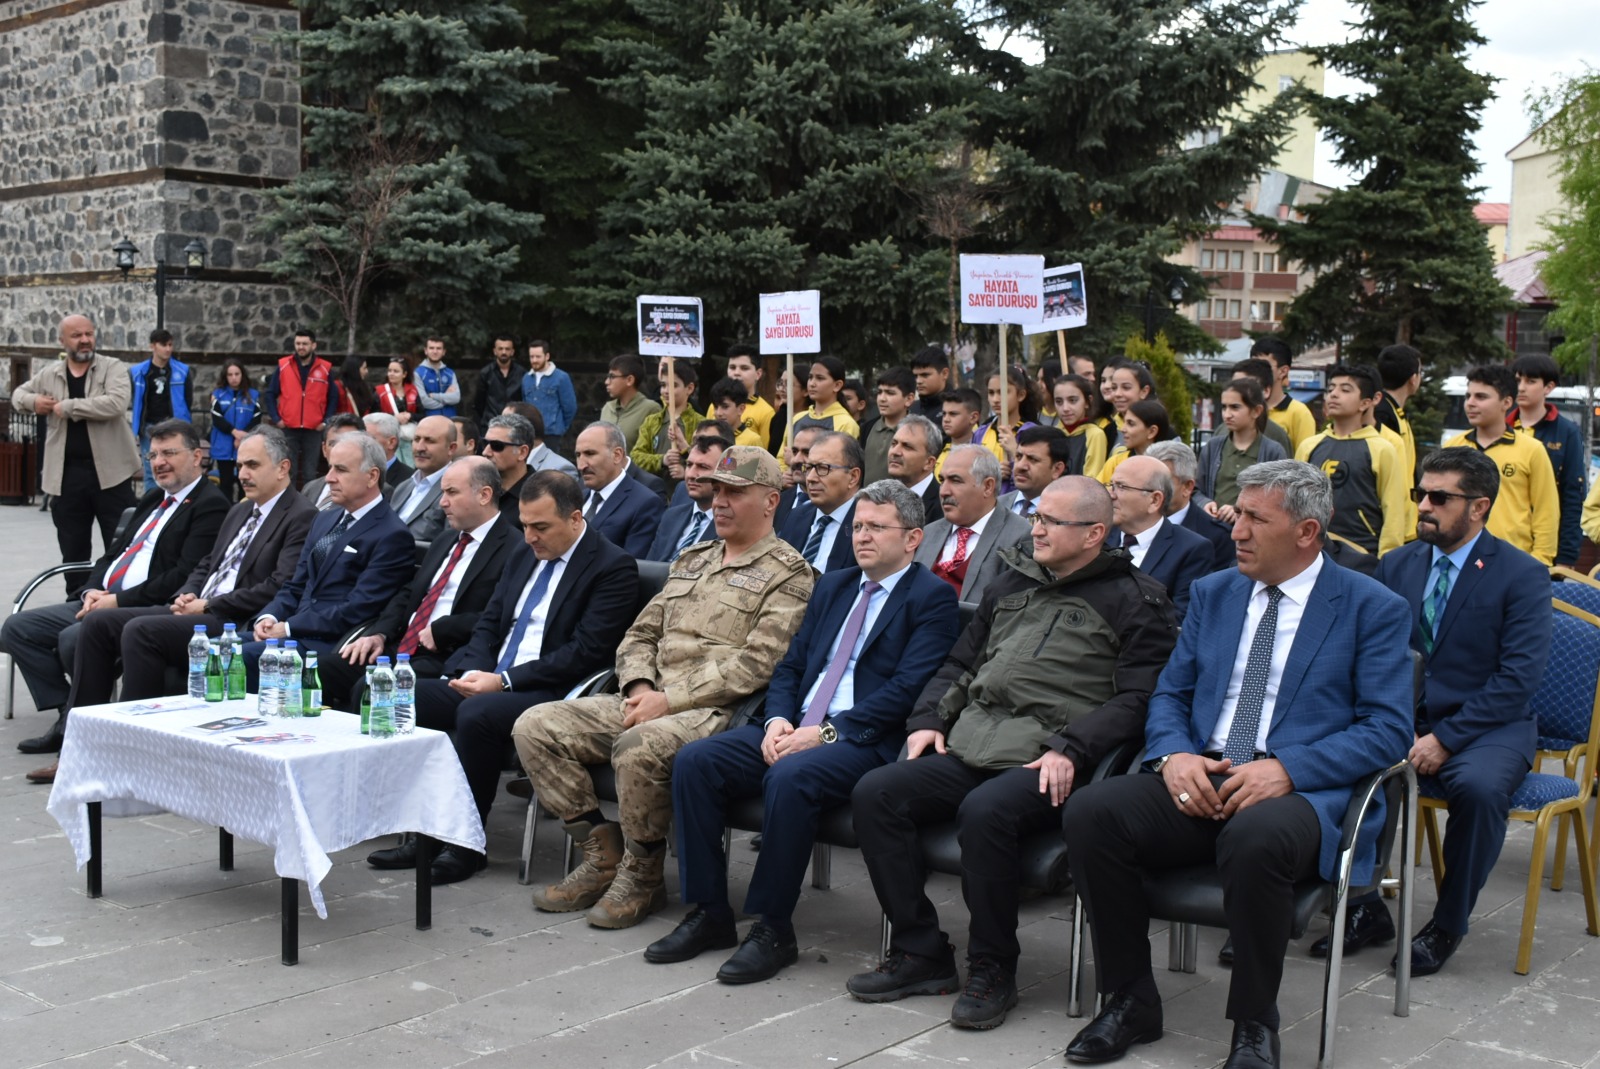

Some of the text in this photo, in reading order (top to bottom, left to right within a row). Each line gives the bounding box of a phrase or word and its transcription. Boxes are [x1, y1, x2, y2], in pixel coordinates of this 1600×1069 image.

[984, 280, 1019, 293] HAYATA
[968, 293, 1038, 309] SAYGI DURUŞU
[776, 313, 801, 325] HAYATA
[765, 325, 814, 339] SAYGI DURUŞU
